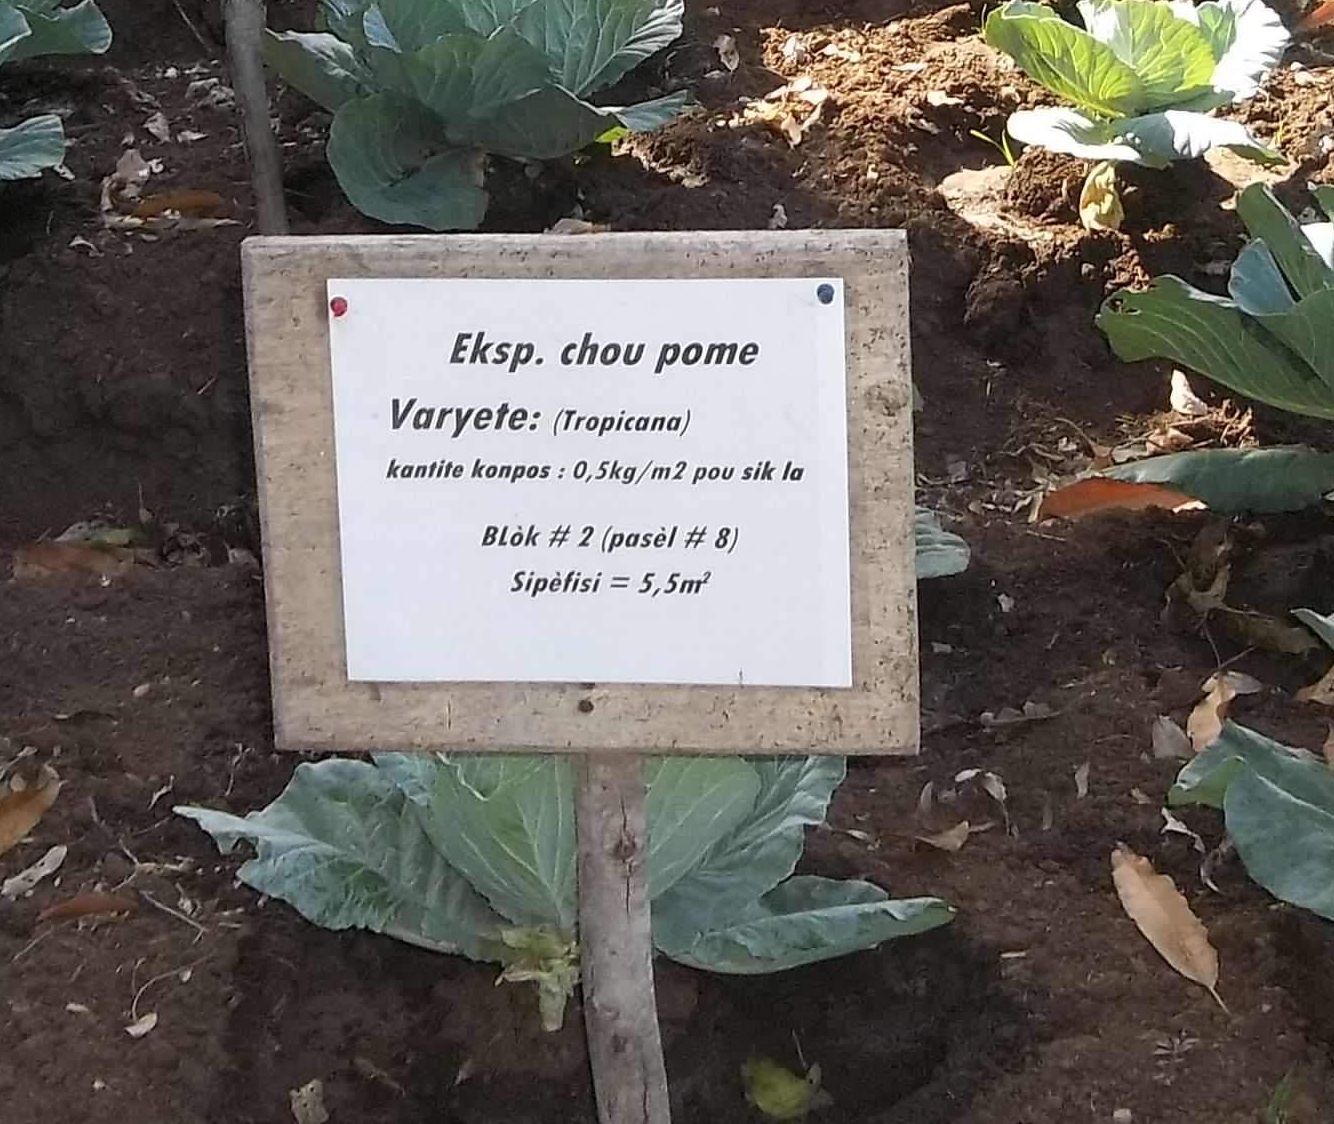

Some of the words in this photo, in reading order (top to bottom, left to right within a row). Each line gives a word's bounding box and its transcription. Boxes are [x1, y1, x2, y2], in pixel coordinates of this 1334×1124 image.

[449, 331, 545, 374] Eksp.
[560, 332, 645, 367] chou
[654, 338, 760, 374] pome
[389, 397, 542, 439] Varyete:
[552, 408, 692, 437] (Tropicana)
[386, 459, 464, 480] kantite
[471, 459, 551, 483] konpos
[573, 460, 687, 485] 0,5kg/m2
[692, 464, 735, 485] pou
[741, 461, 774, 481] sik
[781, 461, 805, 482] la
[549, 526, 571, 547] #
[578, 526, 595, 548] 2
[601, 525, 676, 554] (pasèl
[684, 527, 707, 548] #
[714, 527, 739, 554] 8)
[510, 570, 602, 598] Sipèfisi
[610, 576, 629, 590] =
